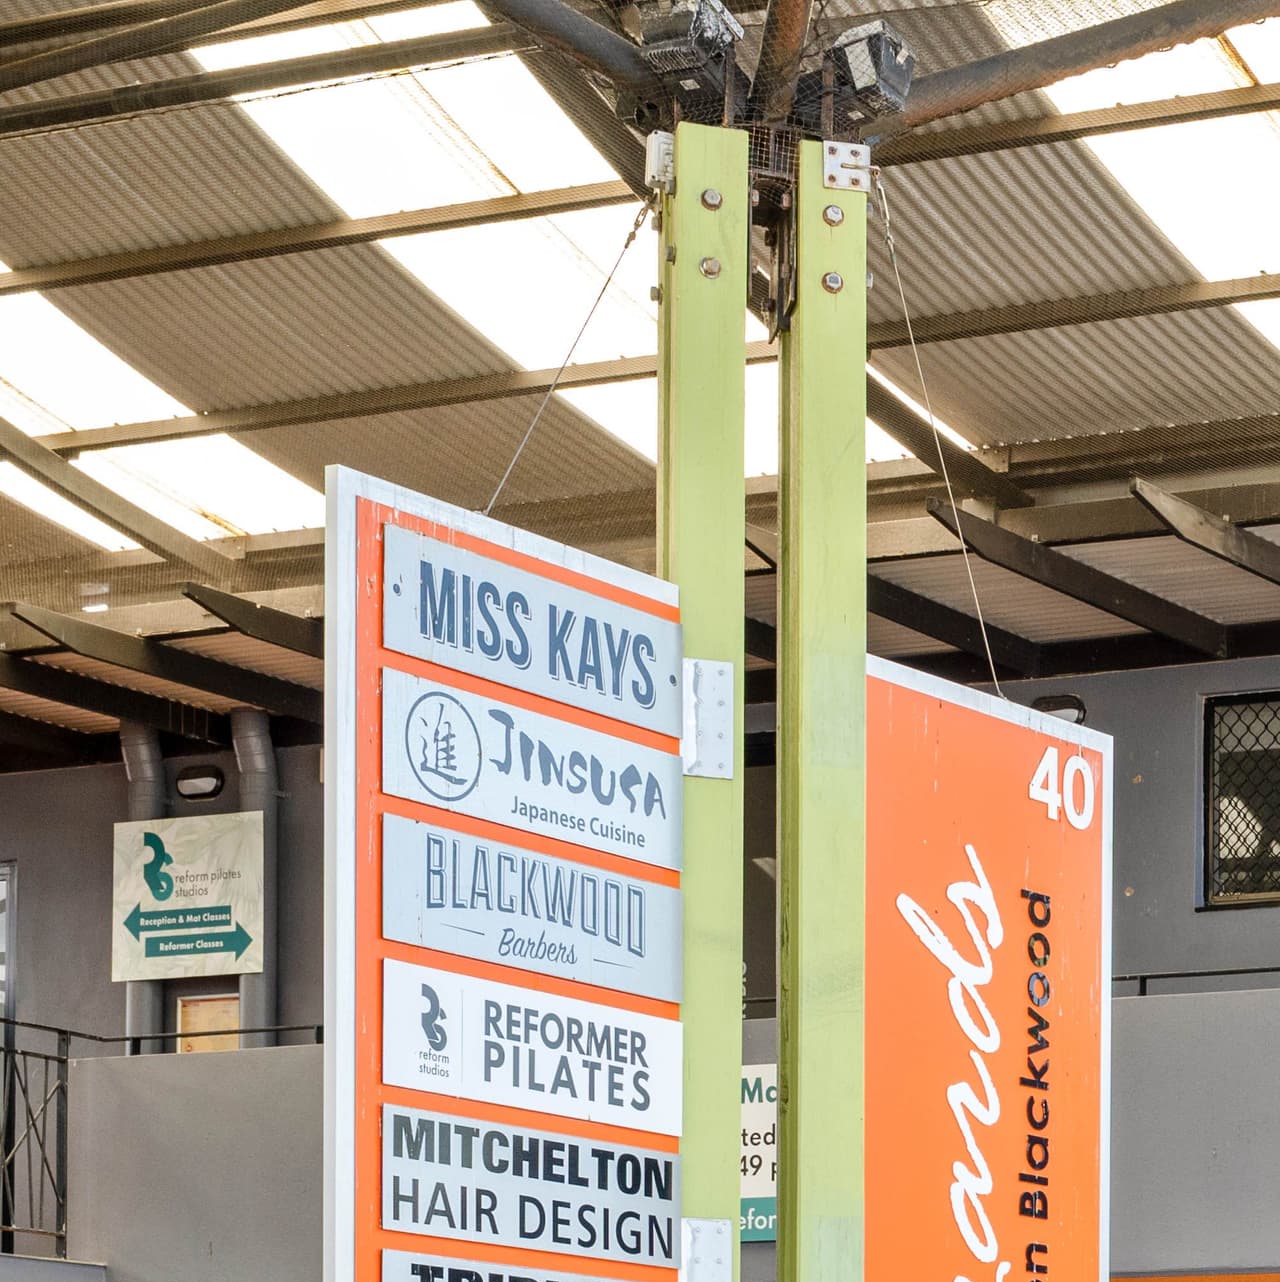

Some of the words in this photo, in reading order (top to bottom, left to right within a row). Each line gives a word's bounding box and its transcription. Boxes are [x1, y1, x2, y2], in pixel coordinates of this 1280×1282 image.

[419, 560, 531, 671] MISS
[548, 603, 657, 709] KAYS
[1028, 745, 1095, 831] 40
[511, 795, 586, 837] Japanese
[589, 816, 646, 848] Cuisine
[175, 870, 209, 884] reform
[211, 869, 242, 886] pilates
[175, 886, 209, 898] studios
[427, 832, 647, 959] BLACKWOOD
[140, 915, 176, 927] Reception
[178, 914, 185, 923] &
[186, 913, 201, 923] Mat
[202, 912, 231, 922] Classes
[159, 941, 194, 951] Reformer
[195, 939, 224, 949] Classes
[499, 926, 578, 966] Barbers
[419, 1049, 450, 1065] reform
[483, 999, 650, 1068] REFORMER
[1019, 888, 1052, 1221] Blackwood
[419, 1062, 450, 1078] studios
[483, 1041, 651, 1112] PILATES
[392, 1114, 673, 1201] MITCHELTON
[392, 1176, 499, 1236] HAIR
[519, 1195, 673, 1260] DESIGN
